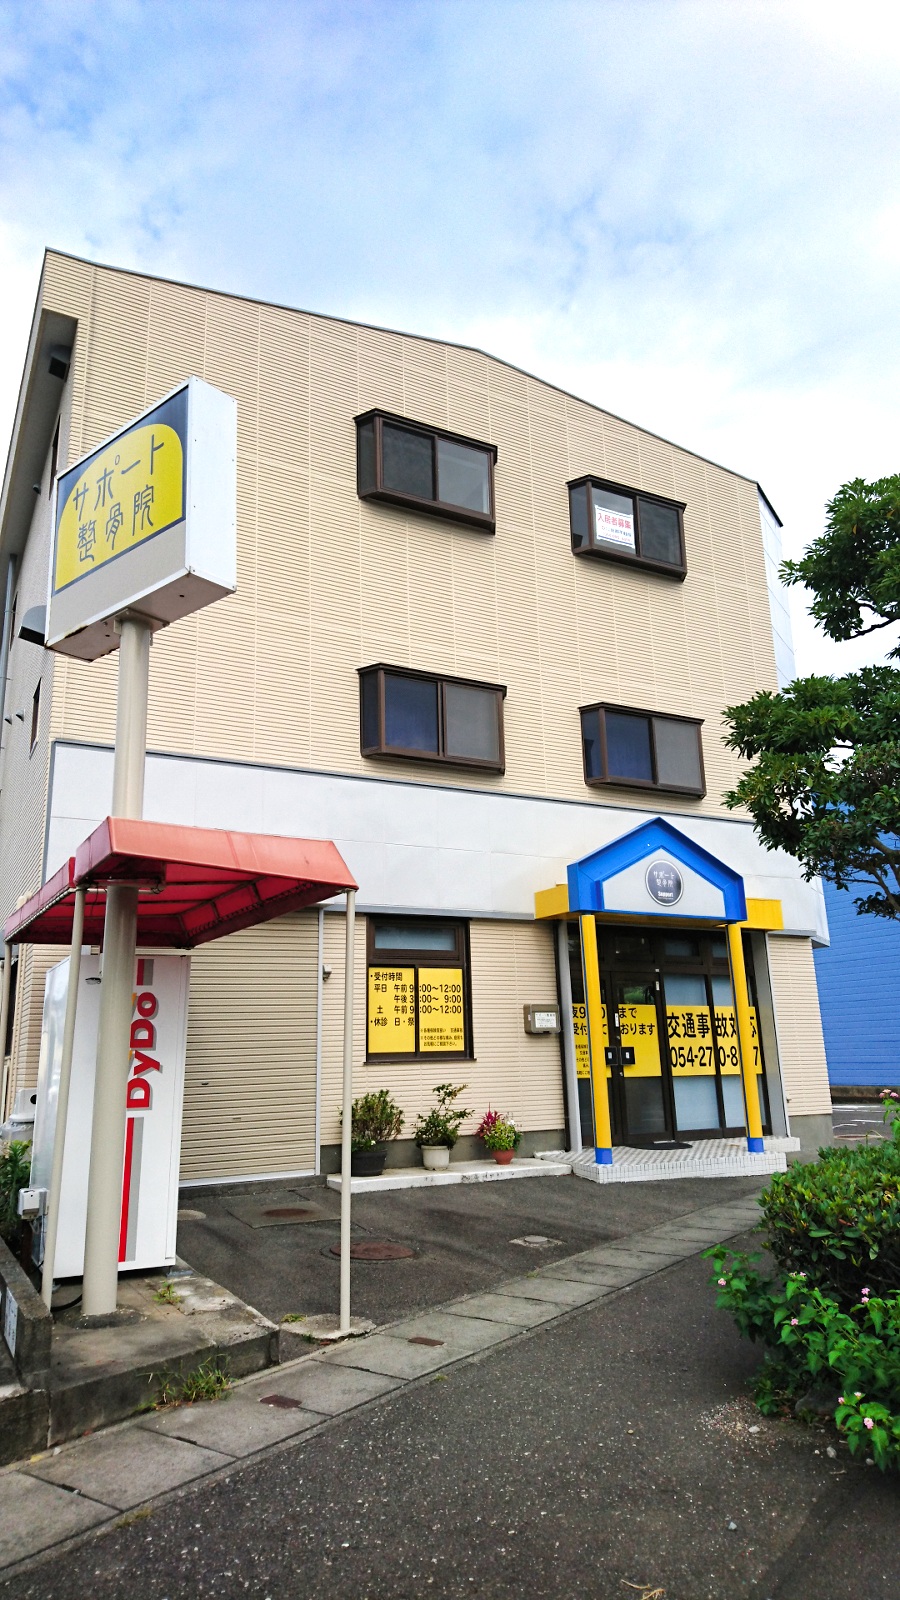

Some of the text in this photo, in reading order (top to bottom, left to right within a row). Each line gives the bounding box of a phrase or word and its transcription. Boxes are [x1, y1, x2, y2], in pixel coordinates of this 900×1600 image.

[72, 433, 165, 522] サポート
[77, 485, 155, 563] 整骨院
[597, 512, 632, 530] 入居者募集
[374, 984, 387, 993] 平日
[376, 1005, 384, 1014] 土
[126, 991, 161, 1109] DyDo
